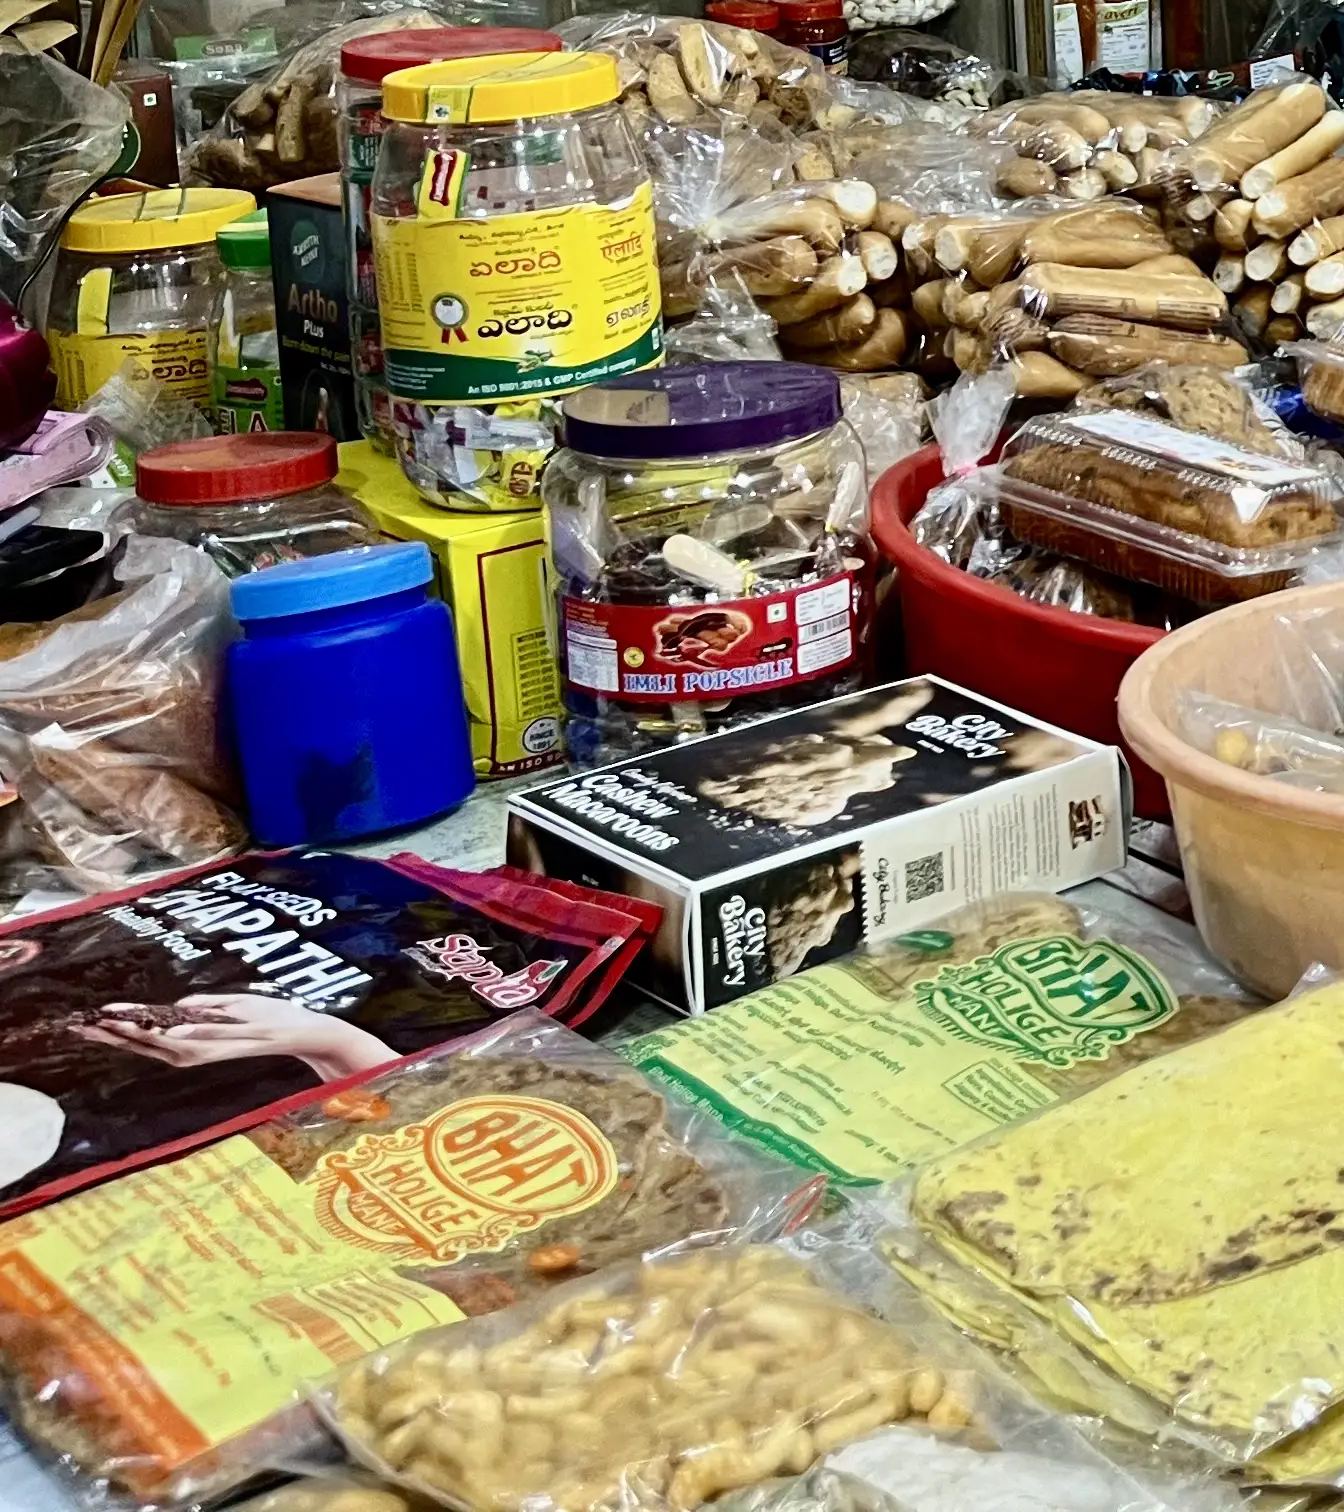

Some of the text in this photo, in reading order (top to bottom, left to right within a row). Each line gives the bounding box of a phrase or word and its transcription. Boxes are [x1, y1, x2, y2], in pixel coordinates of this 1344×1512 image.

[287, 283, 339, 322] Artho
[481, 384, 498, 394] ISO
[552, 371, 575, 386] GMP
[575, 364, 609, 381] Certified
[624, 657, 795, 694] IMLI POPSICLE
[903, 713, 1007, 762] Bakery
[961, 712, 1015, 744] City
[519, 755, 542, 770] ISO
[540, 782, 681, 853] Macaroons
[579, 771, 681, 821] Cashew
[255, 884, 338, 928] SEEDS
[102, 904, 214, 963] Healthy Food
[716, 893, 747, 988] Bakery
[746, 904, 766, 959] City
[963, 968, 1075, 1044] HOLIGE
[444, 1110, 588, 1204] BHAT
[349, 1189, 408, 1237] MANE
[376, 1161, 483, 1234] HOLIGE
